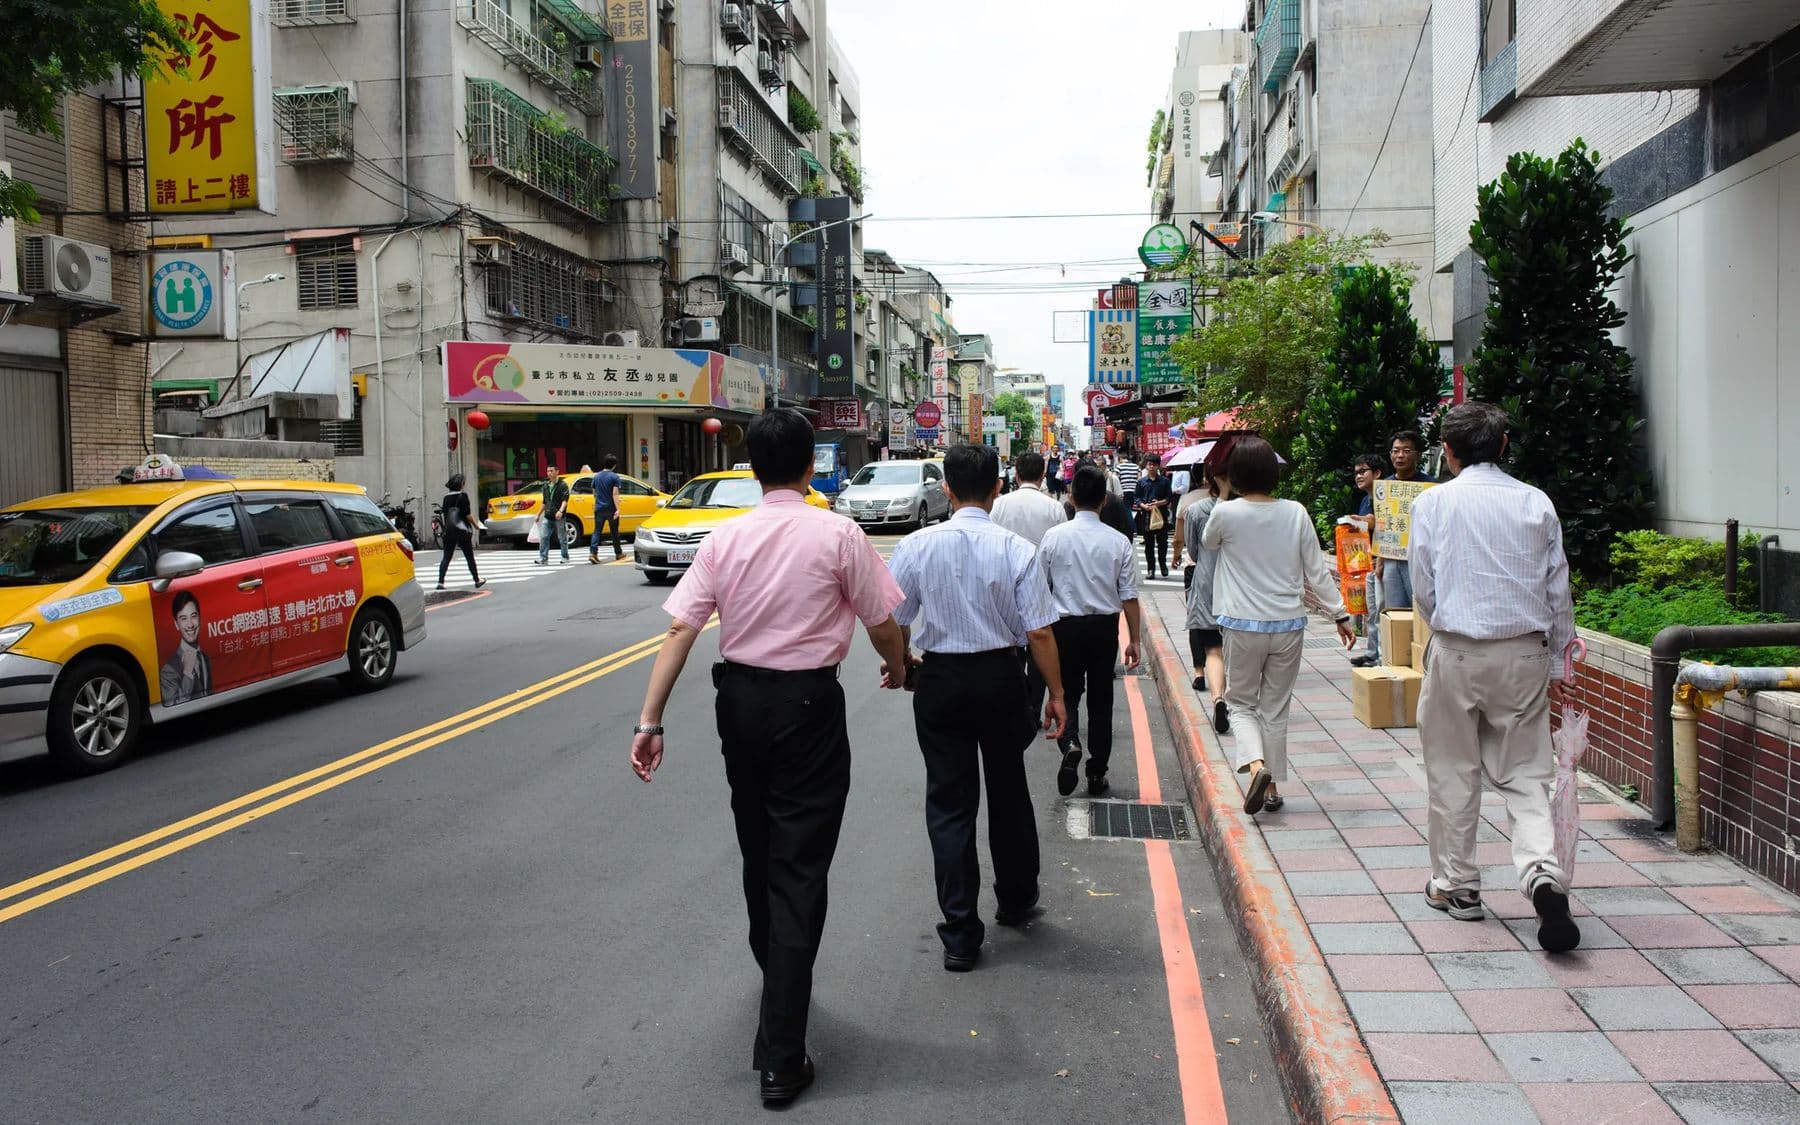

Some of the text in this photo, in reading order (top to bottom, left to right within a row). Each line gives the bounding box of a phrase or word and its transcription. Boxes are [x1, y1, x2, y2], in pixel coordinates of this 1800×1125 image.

[610, 1, 643, 19] 全民
[612, 19, 645, 37] 健保
[165, 12, 240, 160] 診所
[624, 64, 638, 183] 25033977
[156, 174, 250, 205] 請上二樓
[1144, 287, 1187, 308] 全國
[532, 368, 678, 383] 臺北市私立友丞幼兒園
[835, 403, 857, 421] 藥
[208, 606, 281, 637] NCC網路測速
